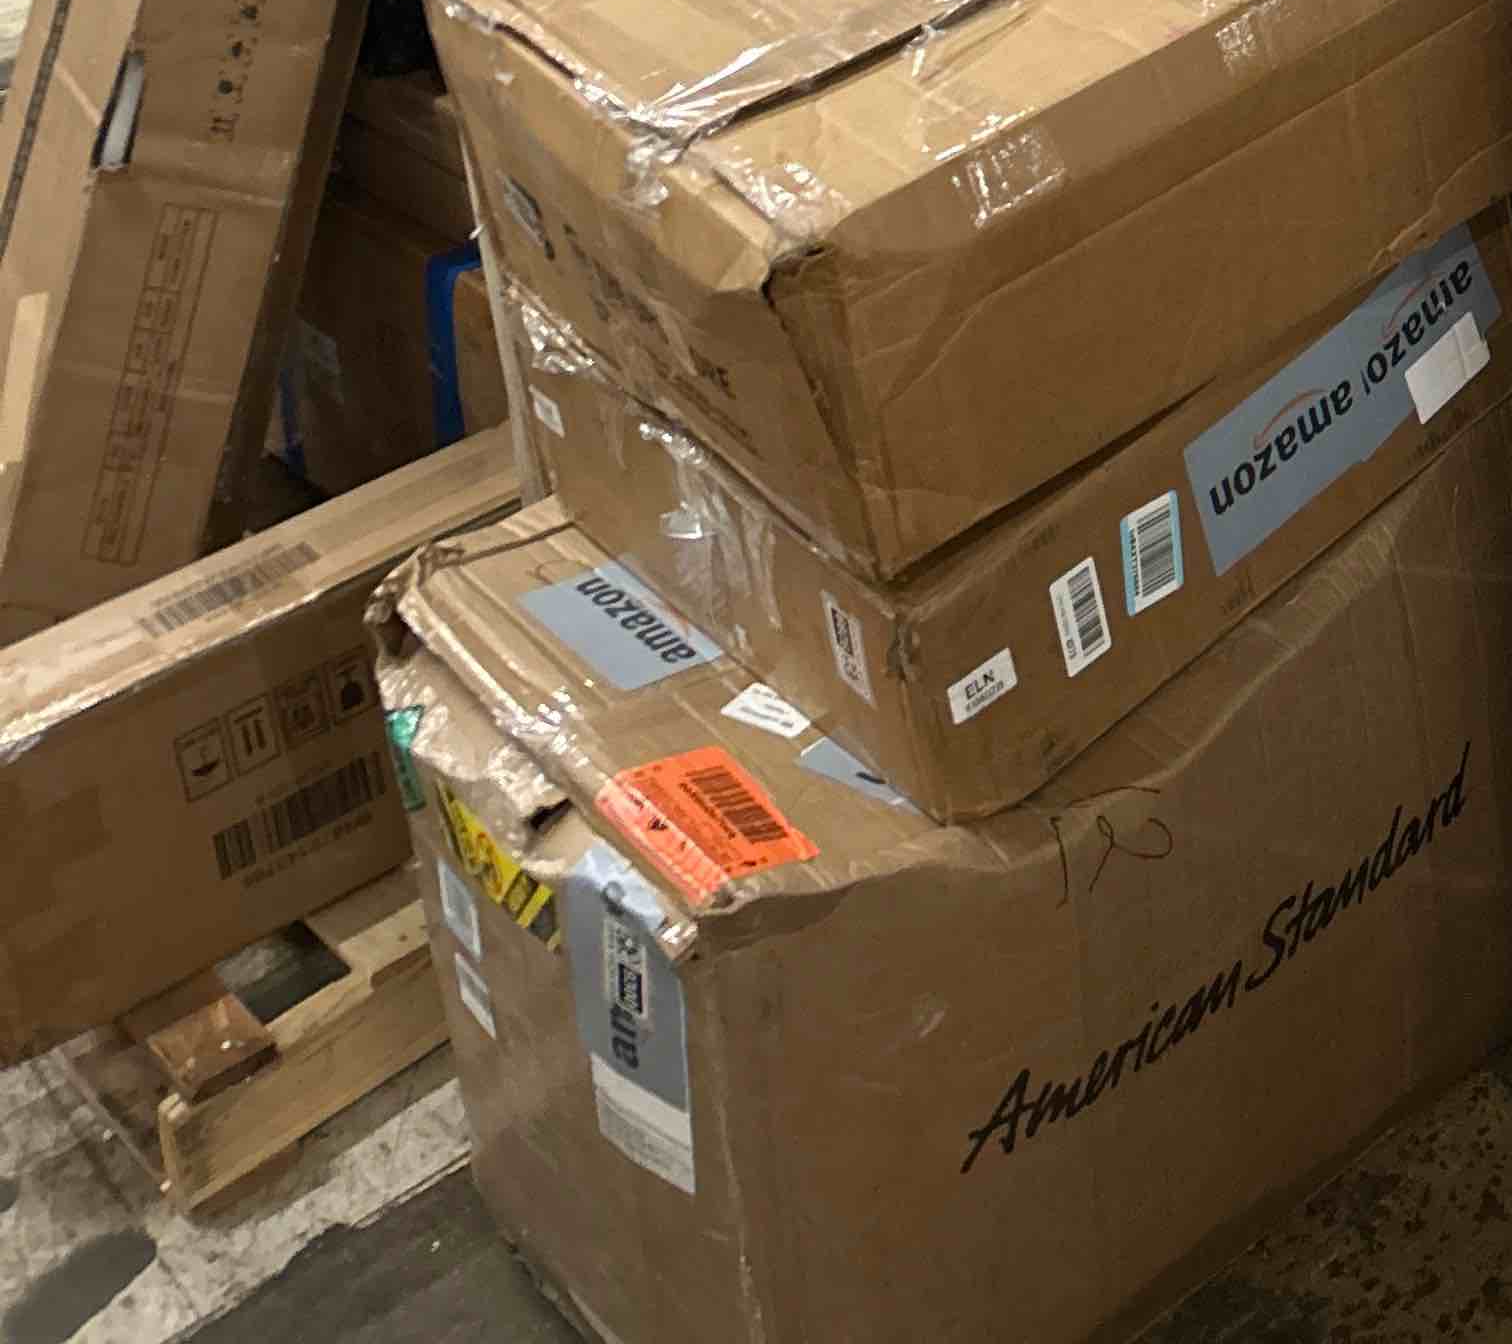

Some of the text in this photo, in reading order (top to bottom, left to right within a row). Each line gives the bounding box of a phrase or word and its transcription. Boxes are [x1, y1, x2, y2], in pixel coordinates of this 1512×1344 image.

[1360, 261, 1475, 395] amazo
[1210, 377, 1356, 518] amazon
[580, 578, 698, 664] amazon
[959, 742, 1472, 1173] American Standard
